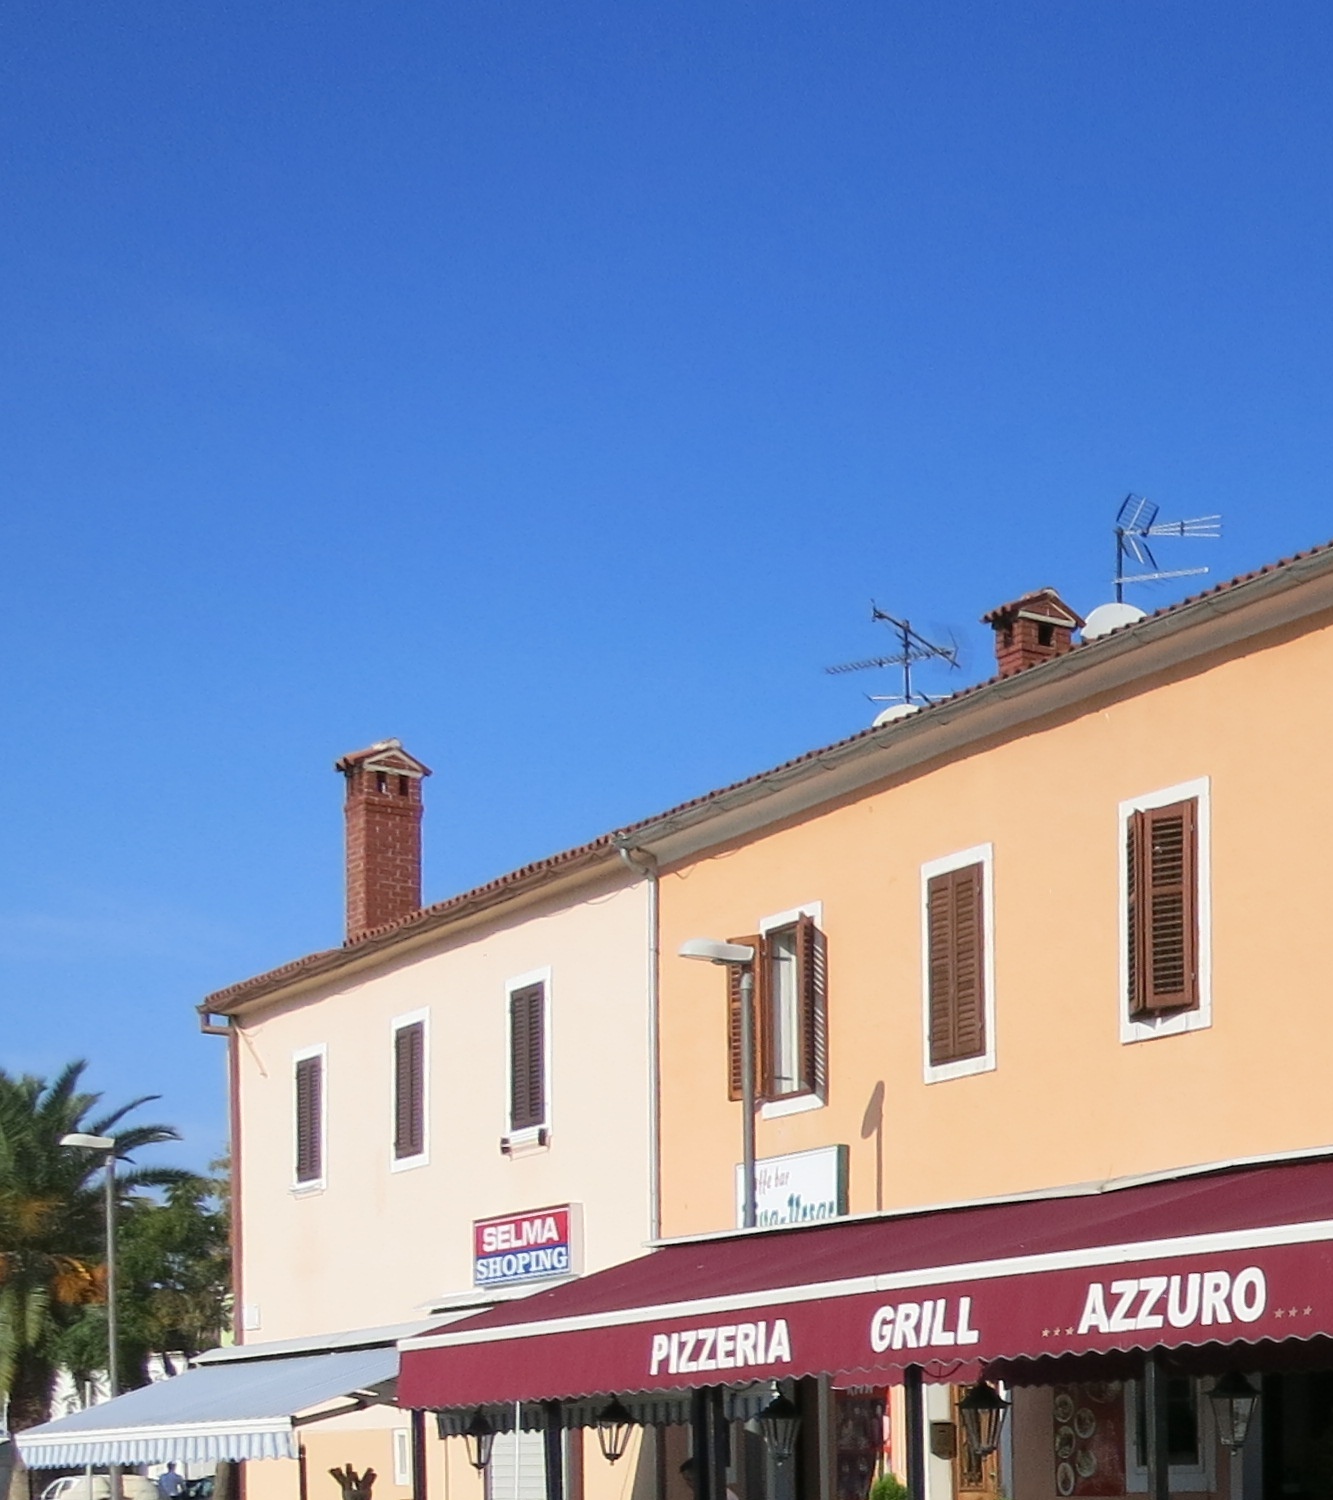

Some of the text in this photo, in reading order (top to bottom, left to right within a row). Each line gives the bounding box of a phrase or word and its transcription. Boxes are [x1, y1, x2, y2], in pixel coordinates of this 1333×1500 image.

[482, 1217, 560, 1252] SELMA
[477, 1247, 568, 1279] SHOPING
[650, 1319, 791, 1376] PIZZERIA
[870, 1296, 979, 1352] GRILL
[1077, 1266, 1266, 1334] AZZURO
